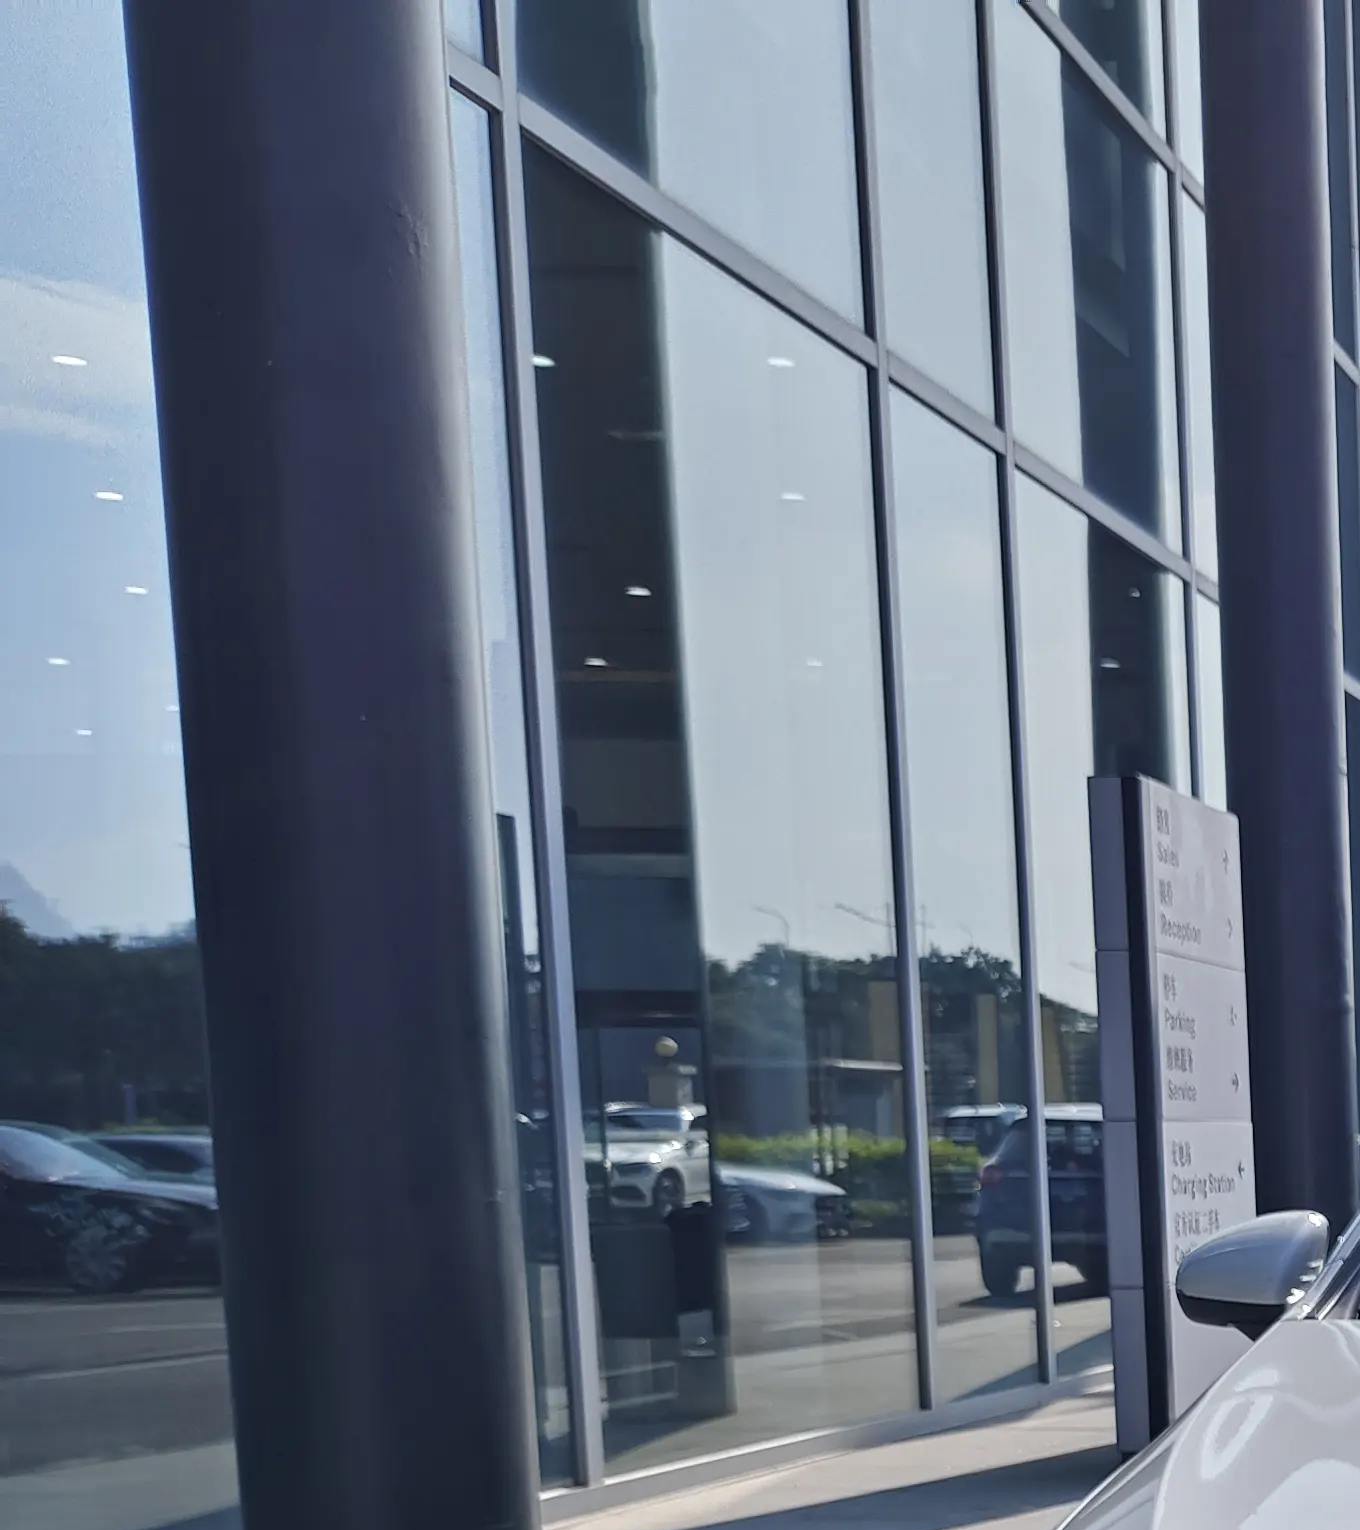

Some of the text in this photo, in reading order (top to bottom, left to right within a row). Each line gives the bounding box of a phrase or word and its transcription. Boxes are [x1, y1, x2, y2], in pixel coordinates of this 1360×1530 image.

[1161, 912, 1201, 945] Reception
[1165, 1007, 1195, 1039] Parking
[1168, 1079, 1197, 1102] Service
[1171, 1173, 1236, 1200] Charging Station
